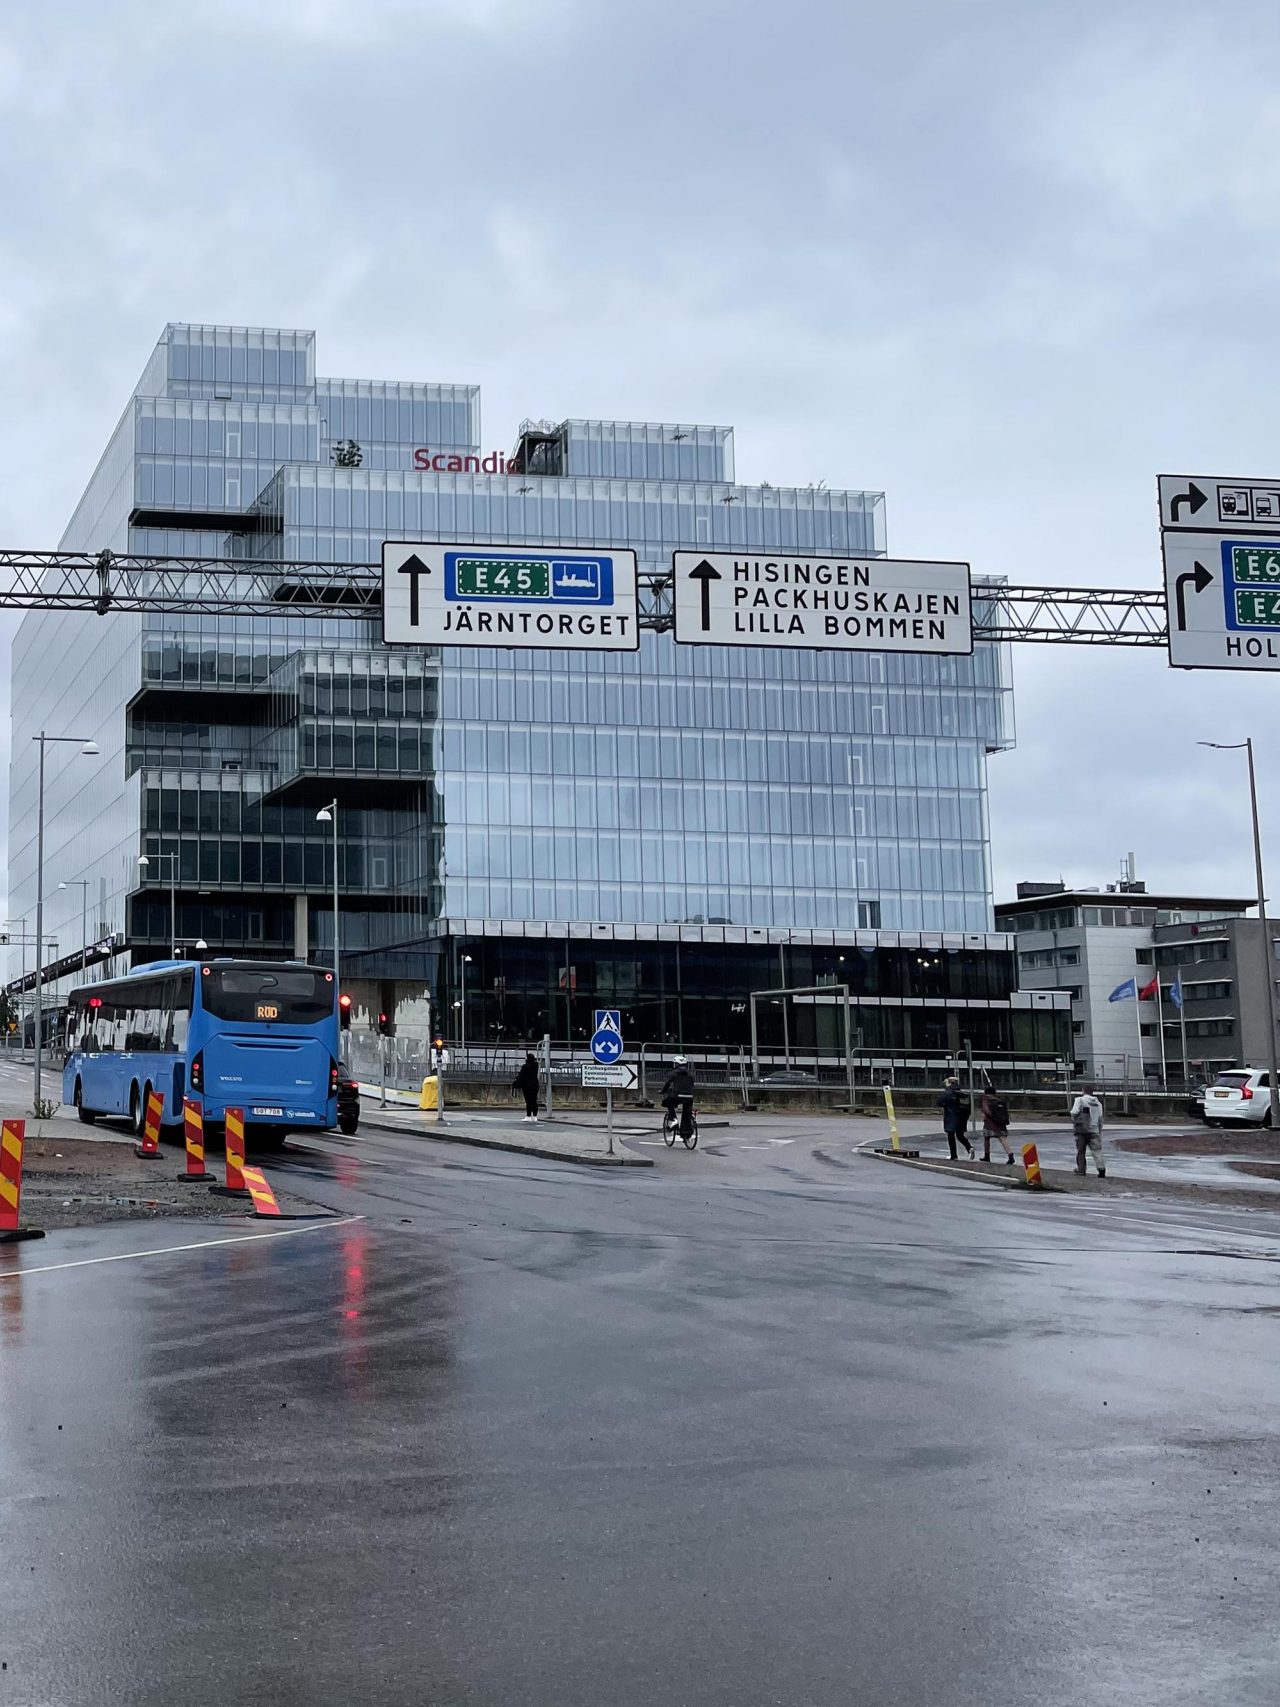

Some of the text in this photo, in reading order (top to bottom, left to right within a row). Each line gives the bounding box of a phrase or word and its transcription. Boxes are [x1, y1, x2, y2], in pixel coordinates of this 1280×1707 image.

[414, 448, 521, 475] Scandic
[476, 567, 532, 589] E45
[734, 561, 870, 587] HISINGEN
[734, 587, 959, 615] PACKHUSKAJEN
[443, 605, 629, 636] JÄRNTORGET
[734, 611, 945, 640] LILLA BOMMEN
